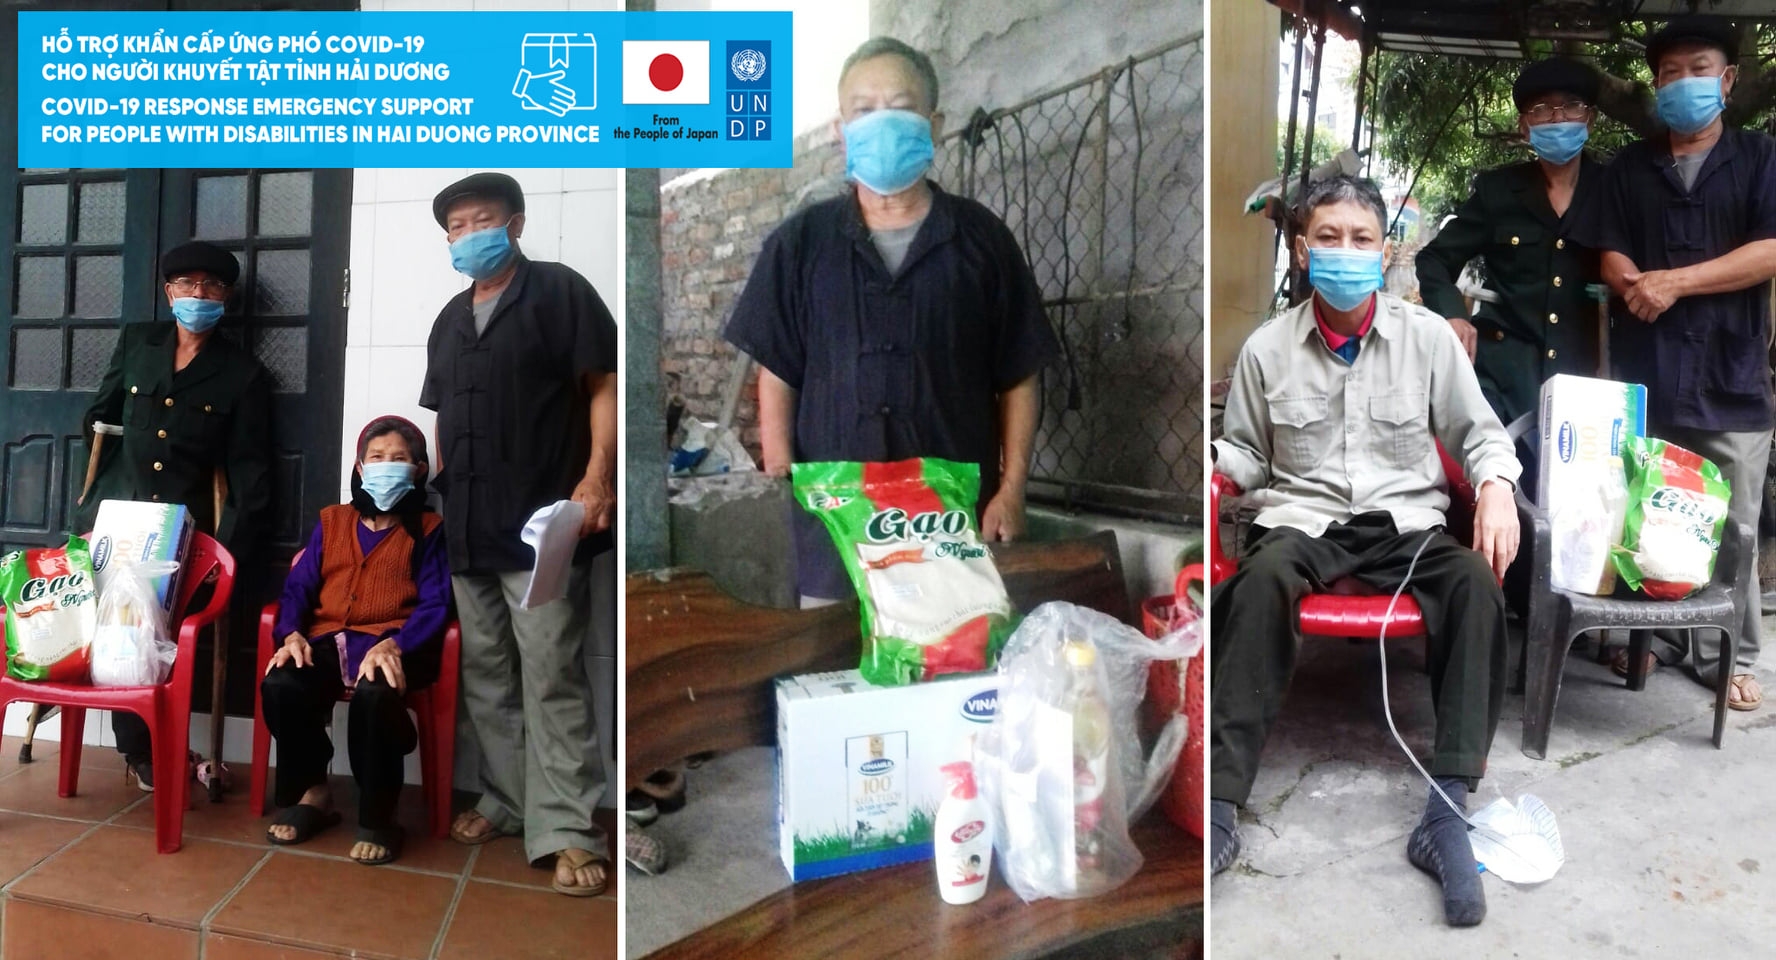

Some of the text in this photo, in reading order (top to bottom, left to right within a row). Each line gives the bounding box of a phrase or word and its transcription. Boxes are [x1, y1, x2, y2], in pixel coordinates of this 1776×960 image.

[868, 509, 967, 540] Gạo
[22, 572, 84, 601] Gạo
[967, 697, 998, 712] VINA
